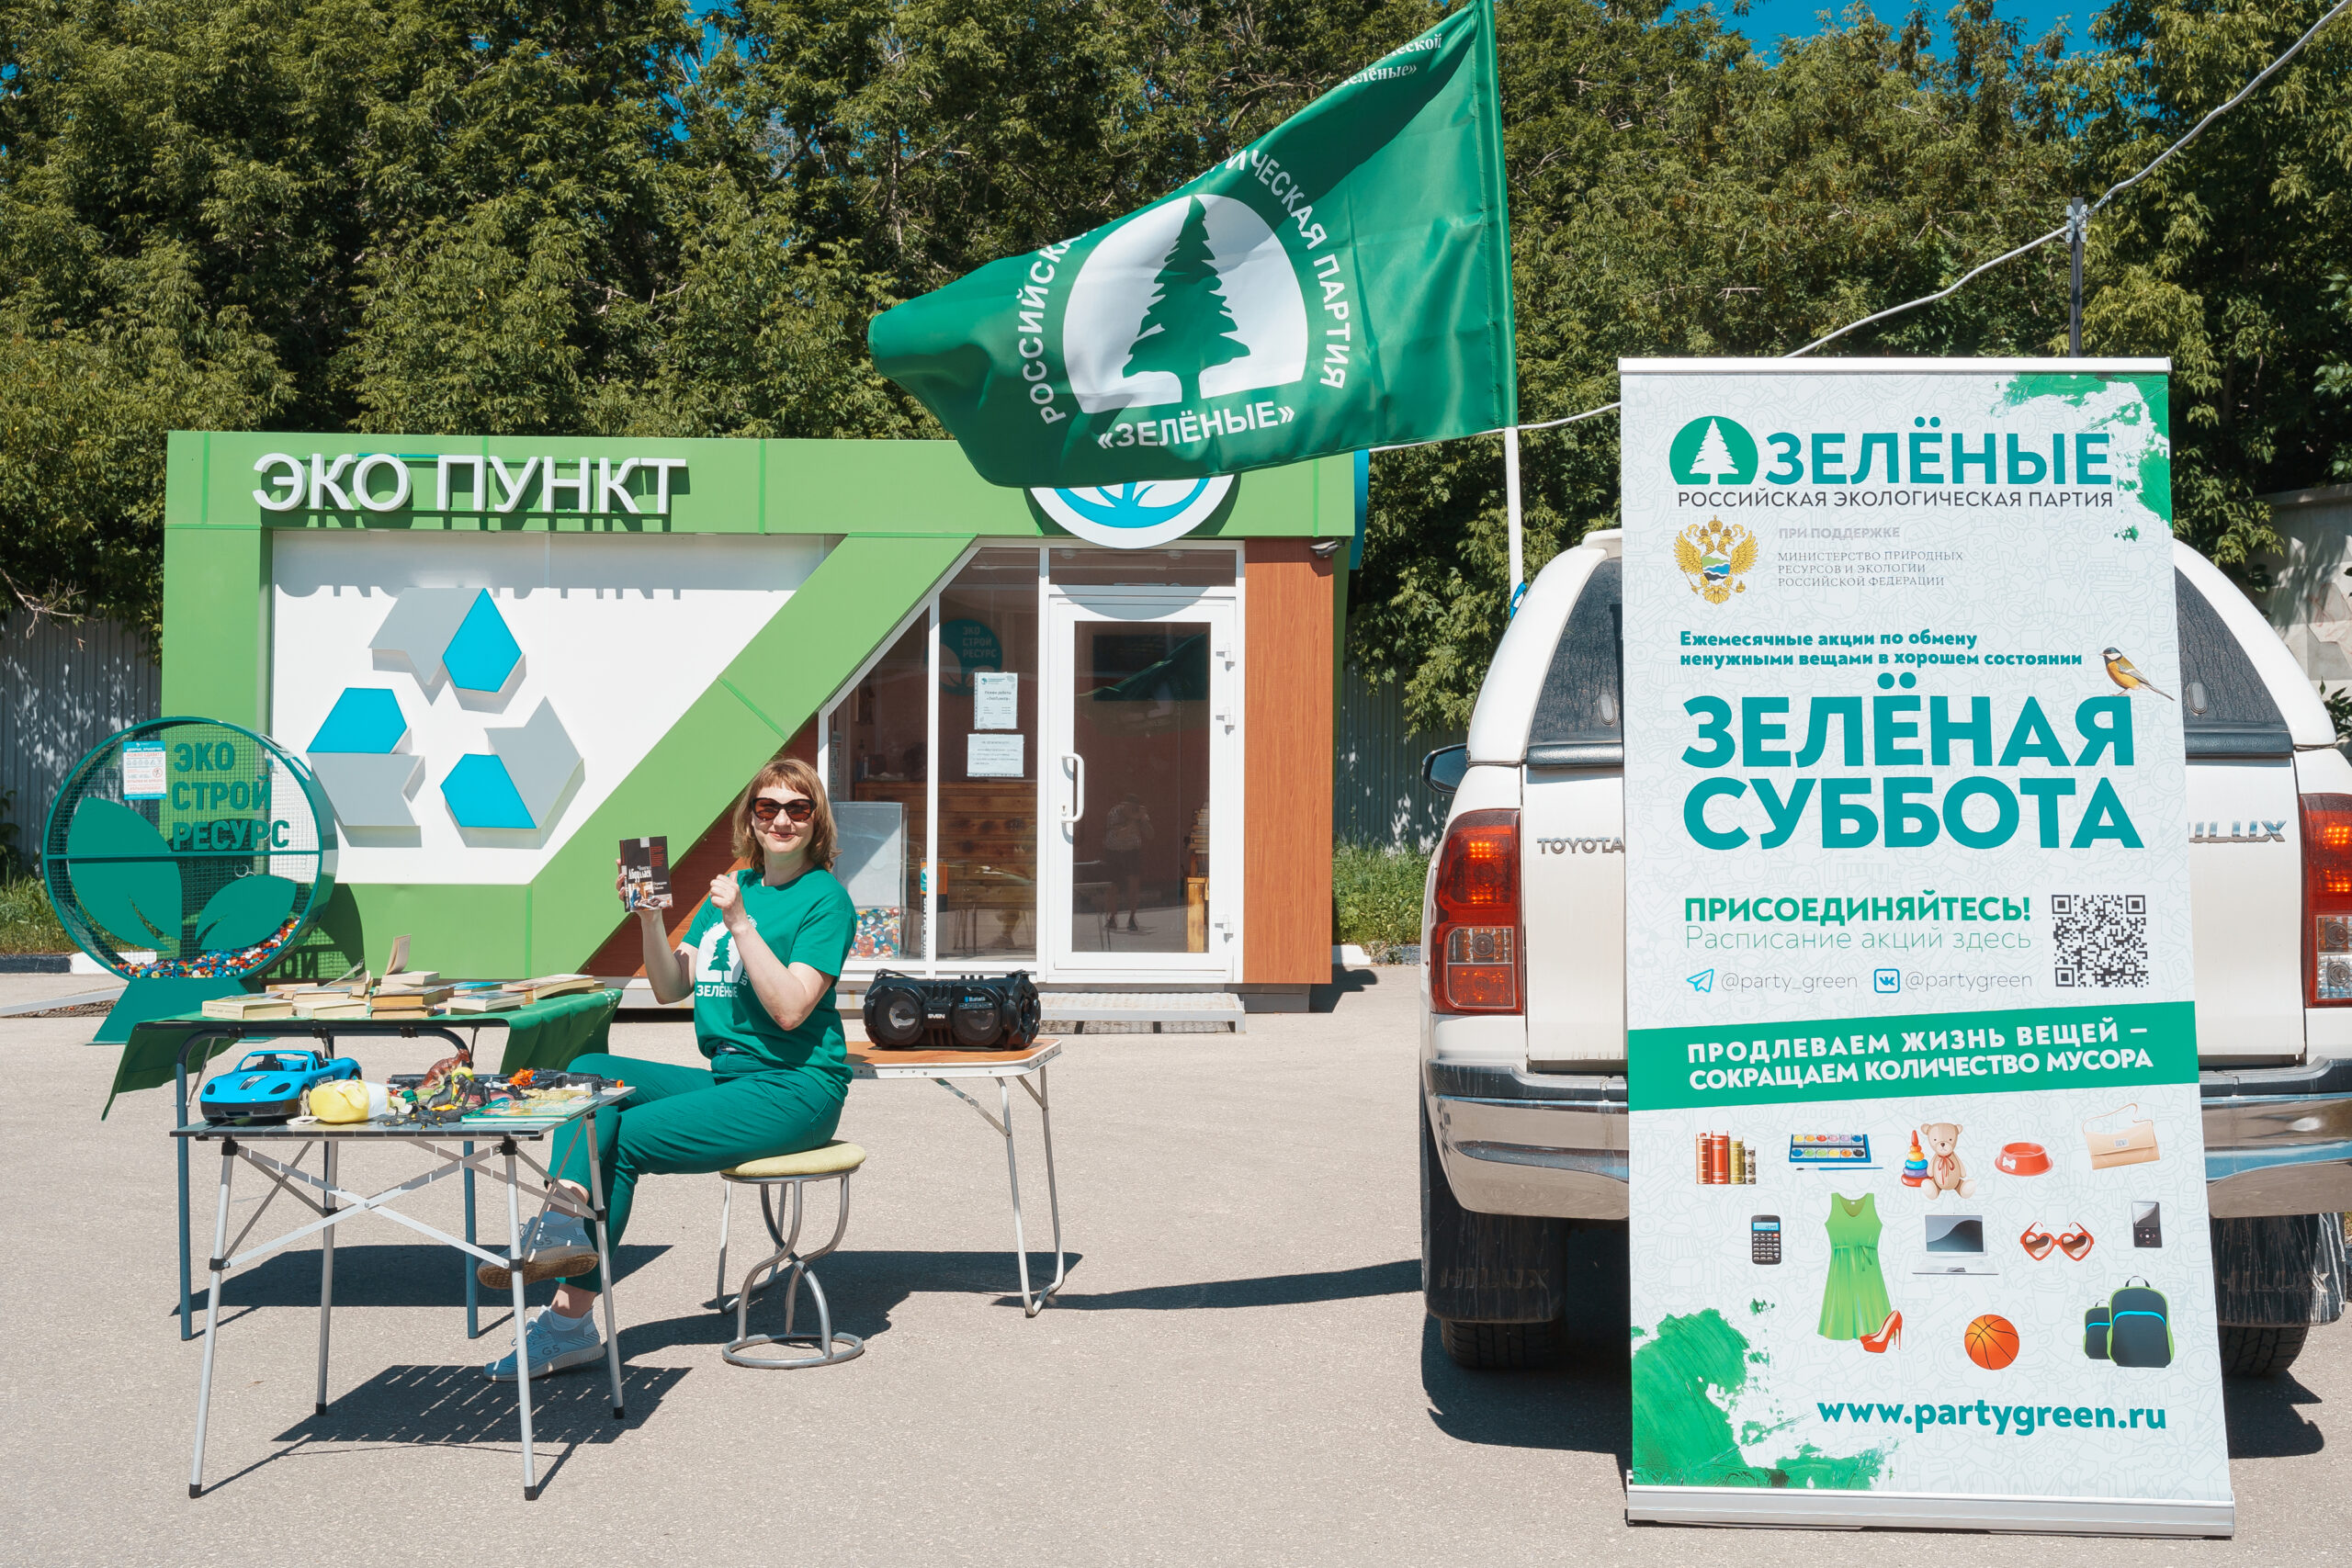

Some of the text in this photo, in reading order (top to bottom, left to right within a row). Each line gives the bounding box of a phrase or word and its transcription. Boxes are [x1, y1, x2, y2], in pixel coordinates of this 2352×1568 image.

[1016, 230, 1093, 424] РОССИЙСКА
[1313, 254, 1351, 389] ПАРТИЯ
[1097, 401, 1295, 448] «ЗЕЛЁНЫЕ»
[1765, 415, 2112, 485] ЗЕЛЁНЫЕ
[252, 453, 687, 514] ЭКО ПУНКТ
[1678, 488, 2113, 508] РОССИЙСКАЯ ЭКОЛОГИЧЕСКАЯ ПАРТИЯ
[1779, 526, 1900, 541] ПРИ ПОДДЕРЖКЕ
[1778, 550, 1963, 562] МИНИСТЕРСТВО ПРИРОДНЫХ
[1778, 563, 1926, 574] РЕСУРСОВ И ЭКОЛОГИИ
[1778, 576, 1944, 587] РОССИЙСКОЙ ФЕДЕРАЦИИ
[1679, 628, 1978, 650] Ежемесячные акции по обмену
[1679, 652, 2082, 669] ненужными вещами в хорошем состоянии
[1682, 672, 2134, 768] ЗЕЛЁНАЯ
[174, 741, 234, 772] ЭКО
[172, 776, 272, 810] СТРОЙ
[1683, 776, 2144, 851] СУББОТА
[173, 819, 290, 851] РЕСУРС
[1536, 820, 2287, 854] TOYOTA ILUX
[1685, 889, 2030, 927] ПРИСОЕДИНЯЙТЕСЬ!
[1686, 926, 2031, 953] Расписание акций здесь
[1721, 972, 1858, 994] @party_green
[1905, 971, 2032, 993] @partygreen
[1687, 1033, 1891, 1064] ПРОДЛЕВАЕМ
[1901, 1028, 2006, 1053] ЖИЗНЬ
[2017, 1017, 2119, 1047] ВЕЩЕЙ
[1689, 1047, 2154, 1090] СОКРАЩАЕМ КОЛИЧЕСТВО МУСОРА
[1817, 1399, 2166, 1437] www.partygreen.ru
